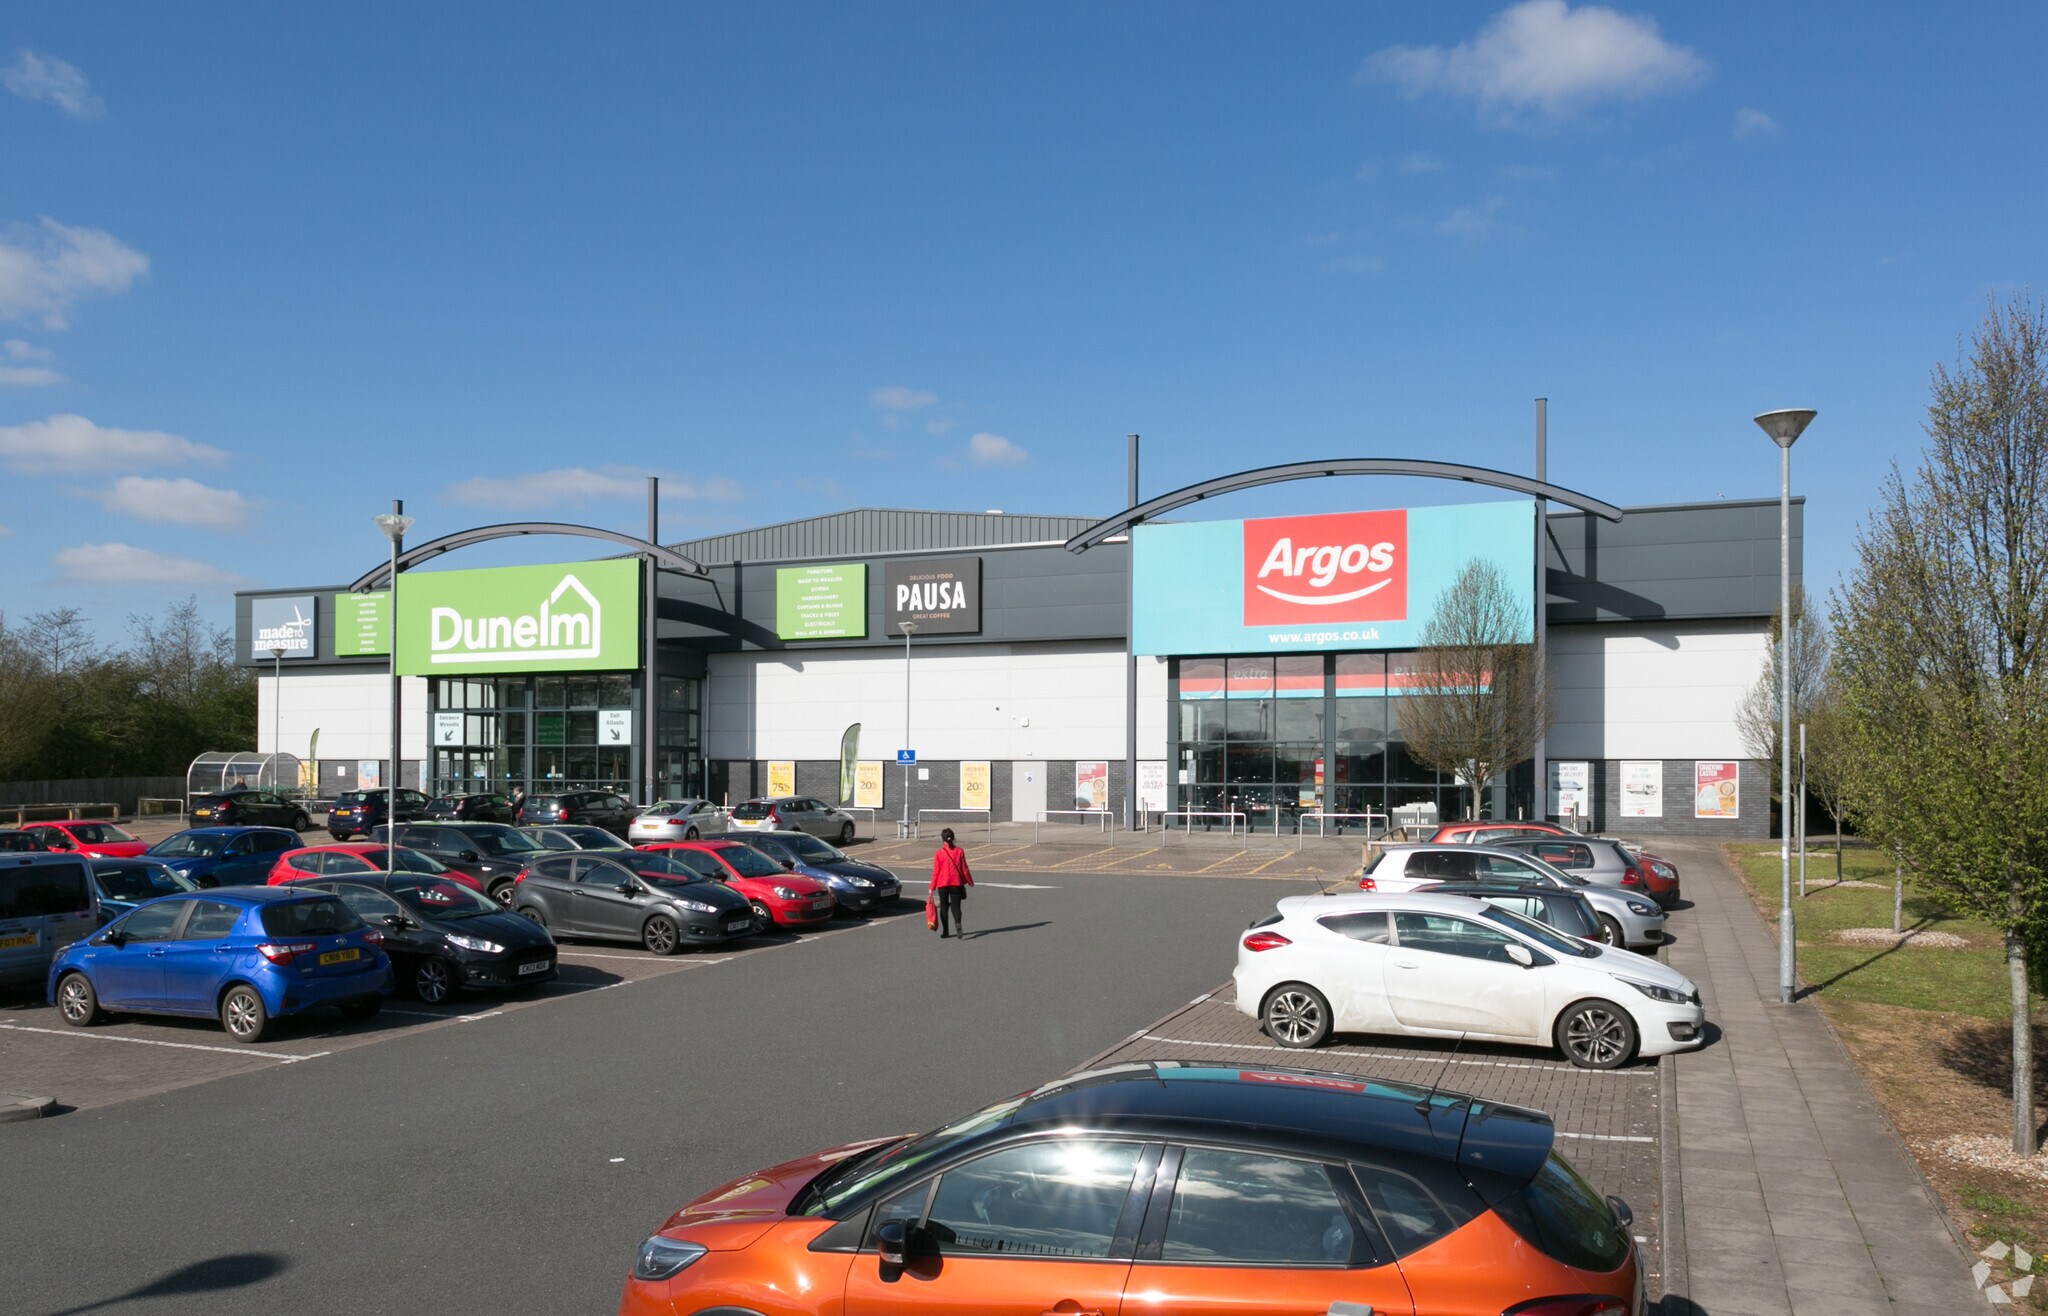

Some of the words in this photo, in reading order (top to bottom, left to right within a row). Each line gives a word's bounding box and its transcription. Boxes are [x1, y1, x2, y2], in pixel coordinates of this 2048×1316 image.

[1257, 538, 1395, 587] Argos
[896, 581, 967, 611] PAUSA
[259, 625, 293, 640] made
[293, 630, 304, 638] TO
[431, 598, 590, 650] Dunelm
[254, 638, 309, 651] measure
[1269, 628, 1380, 645] www.argos.co.uk
[1233, 668, 1268, 680] extra
